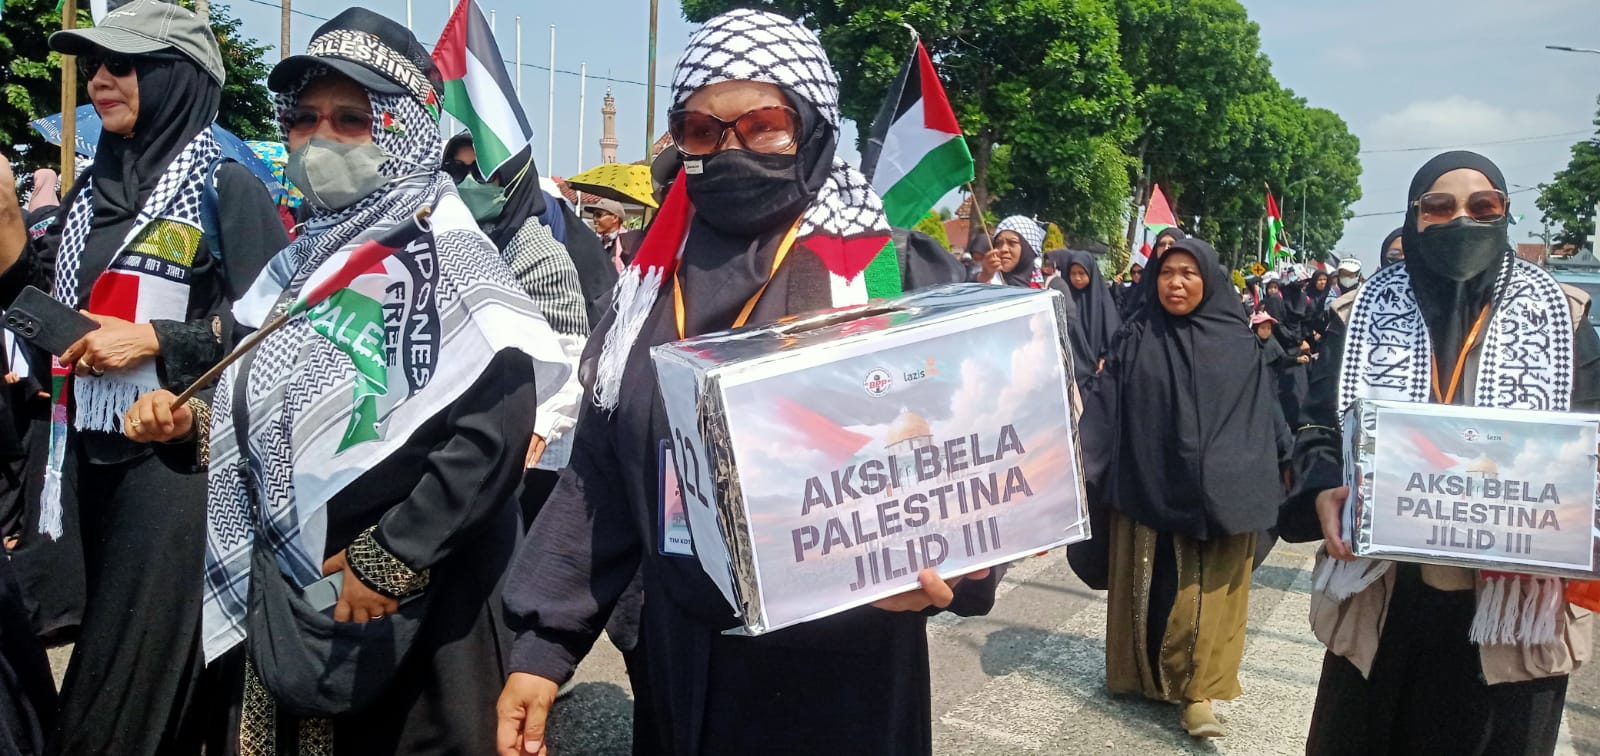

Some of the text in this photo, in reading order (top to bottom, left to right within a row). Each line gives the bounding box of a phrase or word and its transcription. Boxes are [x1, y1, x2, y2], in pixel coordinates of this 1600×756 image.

[307, 39, 422, 94] ALESTINE
[342, 32, 389, 56] SAVE
[307, 296, 386, 369] PALE
[383, 281, 405, 367] FREE
[801, 423, 1026, 516] AKSI BELA
[1405, 472, 1561, 505] AKSI BELA
[791, 466, 1033, 563] PALESTINA
[1396, 496, 1561, 531] PALESTINA
[1426, 525, 1532, 555] JILID III
[849, 516, 1001, 592] JILID III
